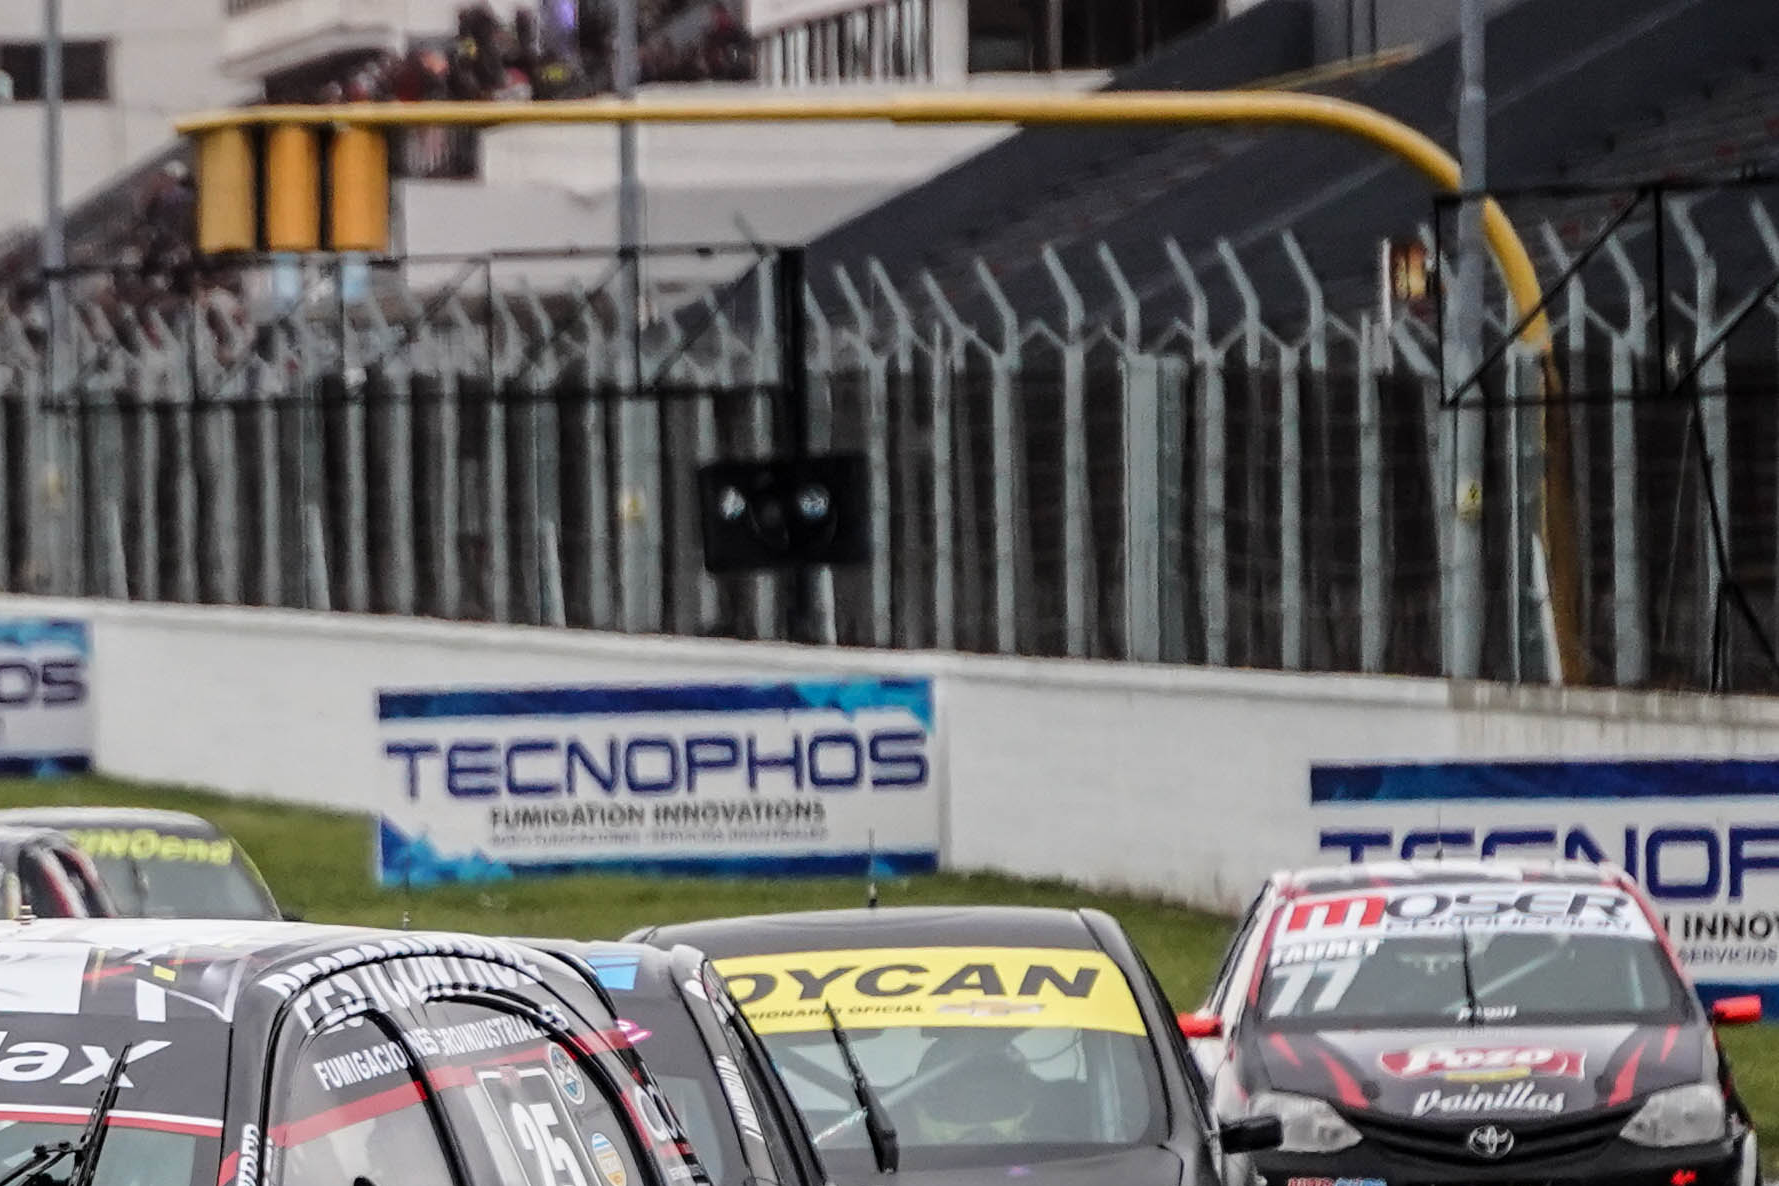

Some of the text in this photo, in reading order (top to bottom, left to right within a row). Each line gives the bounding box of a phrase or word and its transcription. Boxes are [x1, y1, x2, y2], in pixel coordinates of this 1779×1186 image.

[386, 730, 930, 799] TECNOPHOS
[490, 797, 826, 828] FUMIGATION INNOVATIONS
[1683, 909, 1779, 940] INNO
[723, 963, 1101, 1007] OYCAN
[847, 1003, 925, 1016] OFICIAL
